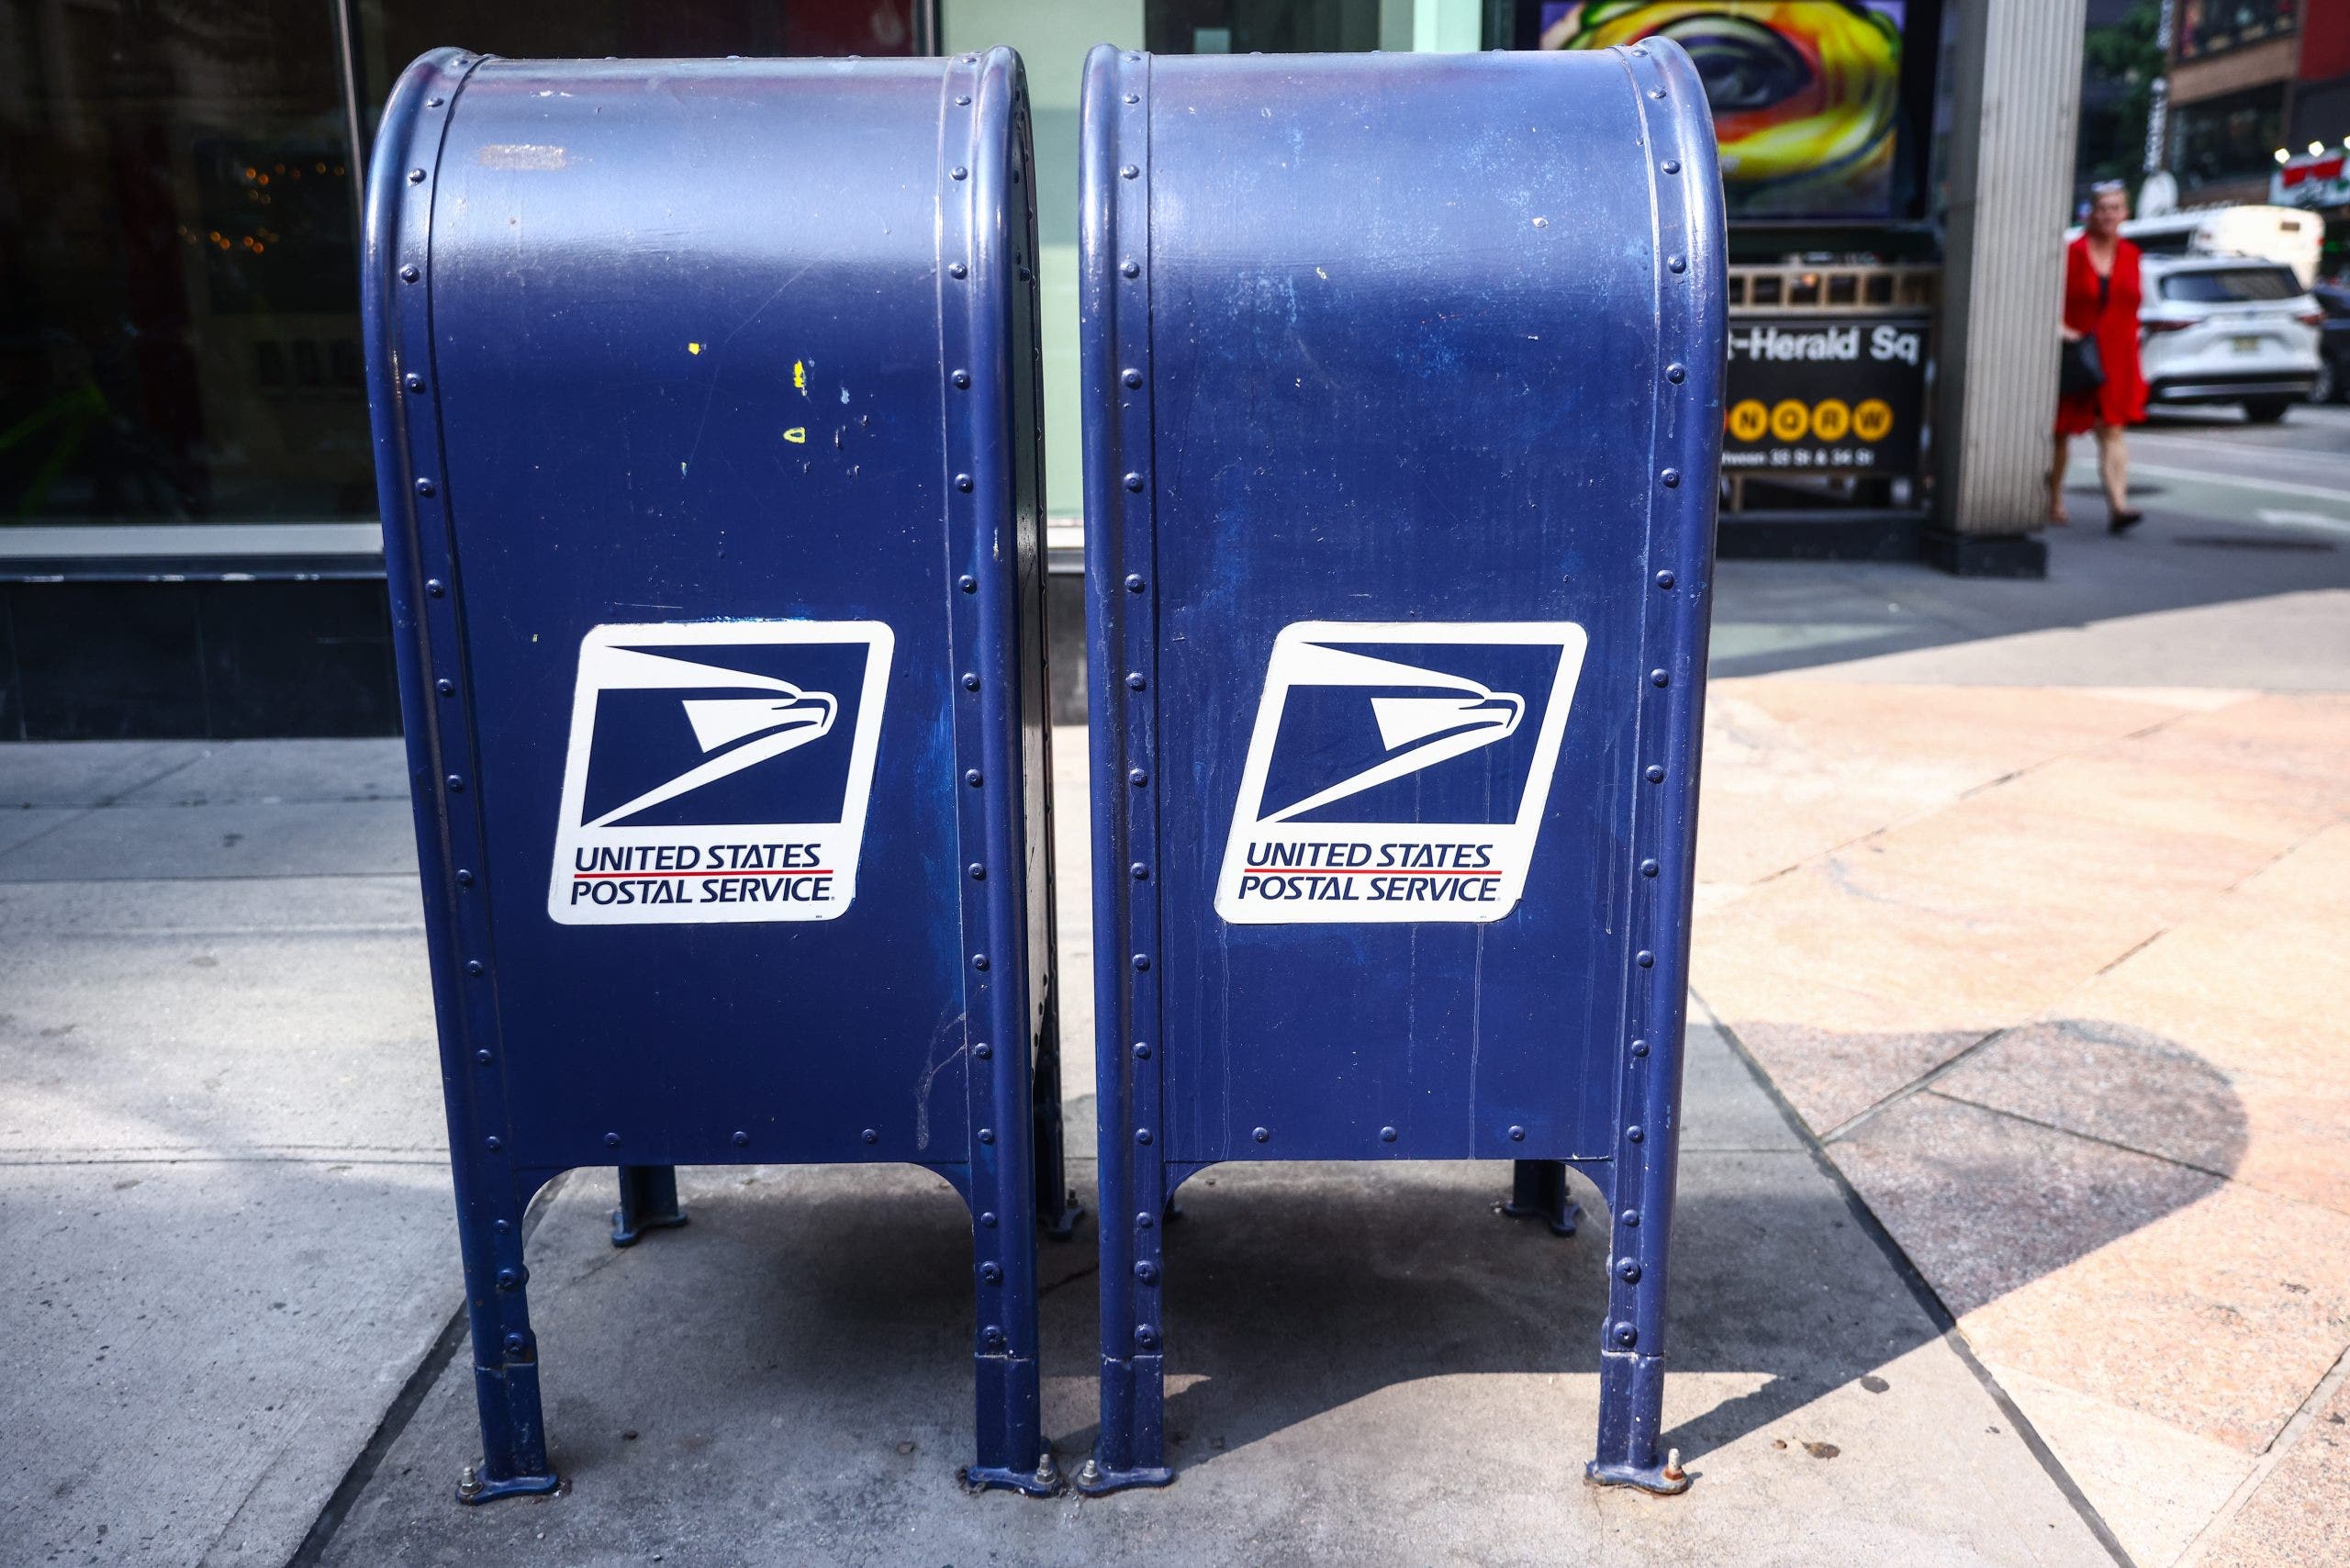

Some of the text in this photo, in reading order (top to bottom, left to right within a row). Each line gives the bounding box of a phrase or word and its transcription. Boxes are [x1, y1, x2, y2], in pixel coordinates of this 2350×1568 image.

[1870, 325, 1919, 365] Sq
[575, 843, 822, 871] UNITED STATES
[1247, 842, 1494, 868] UNITED STATES
[571, 877, 834, 905] POSTAL SERVICE
[1238, 876, 1501, 902] POSTAL SERVICE
